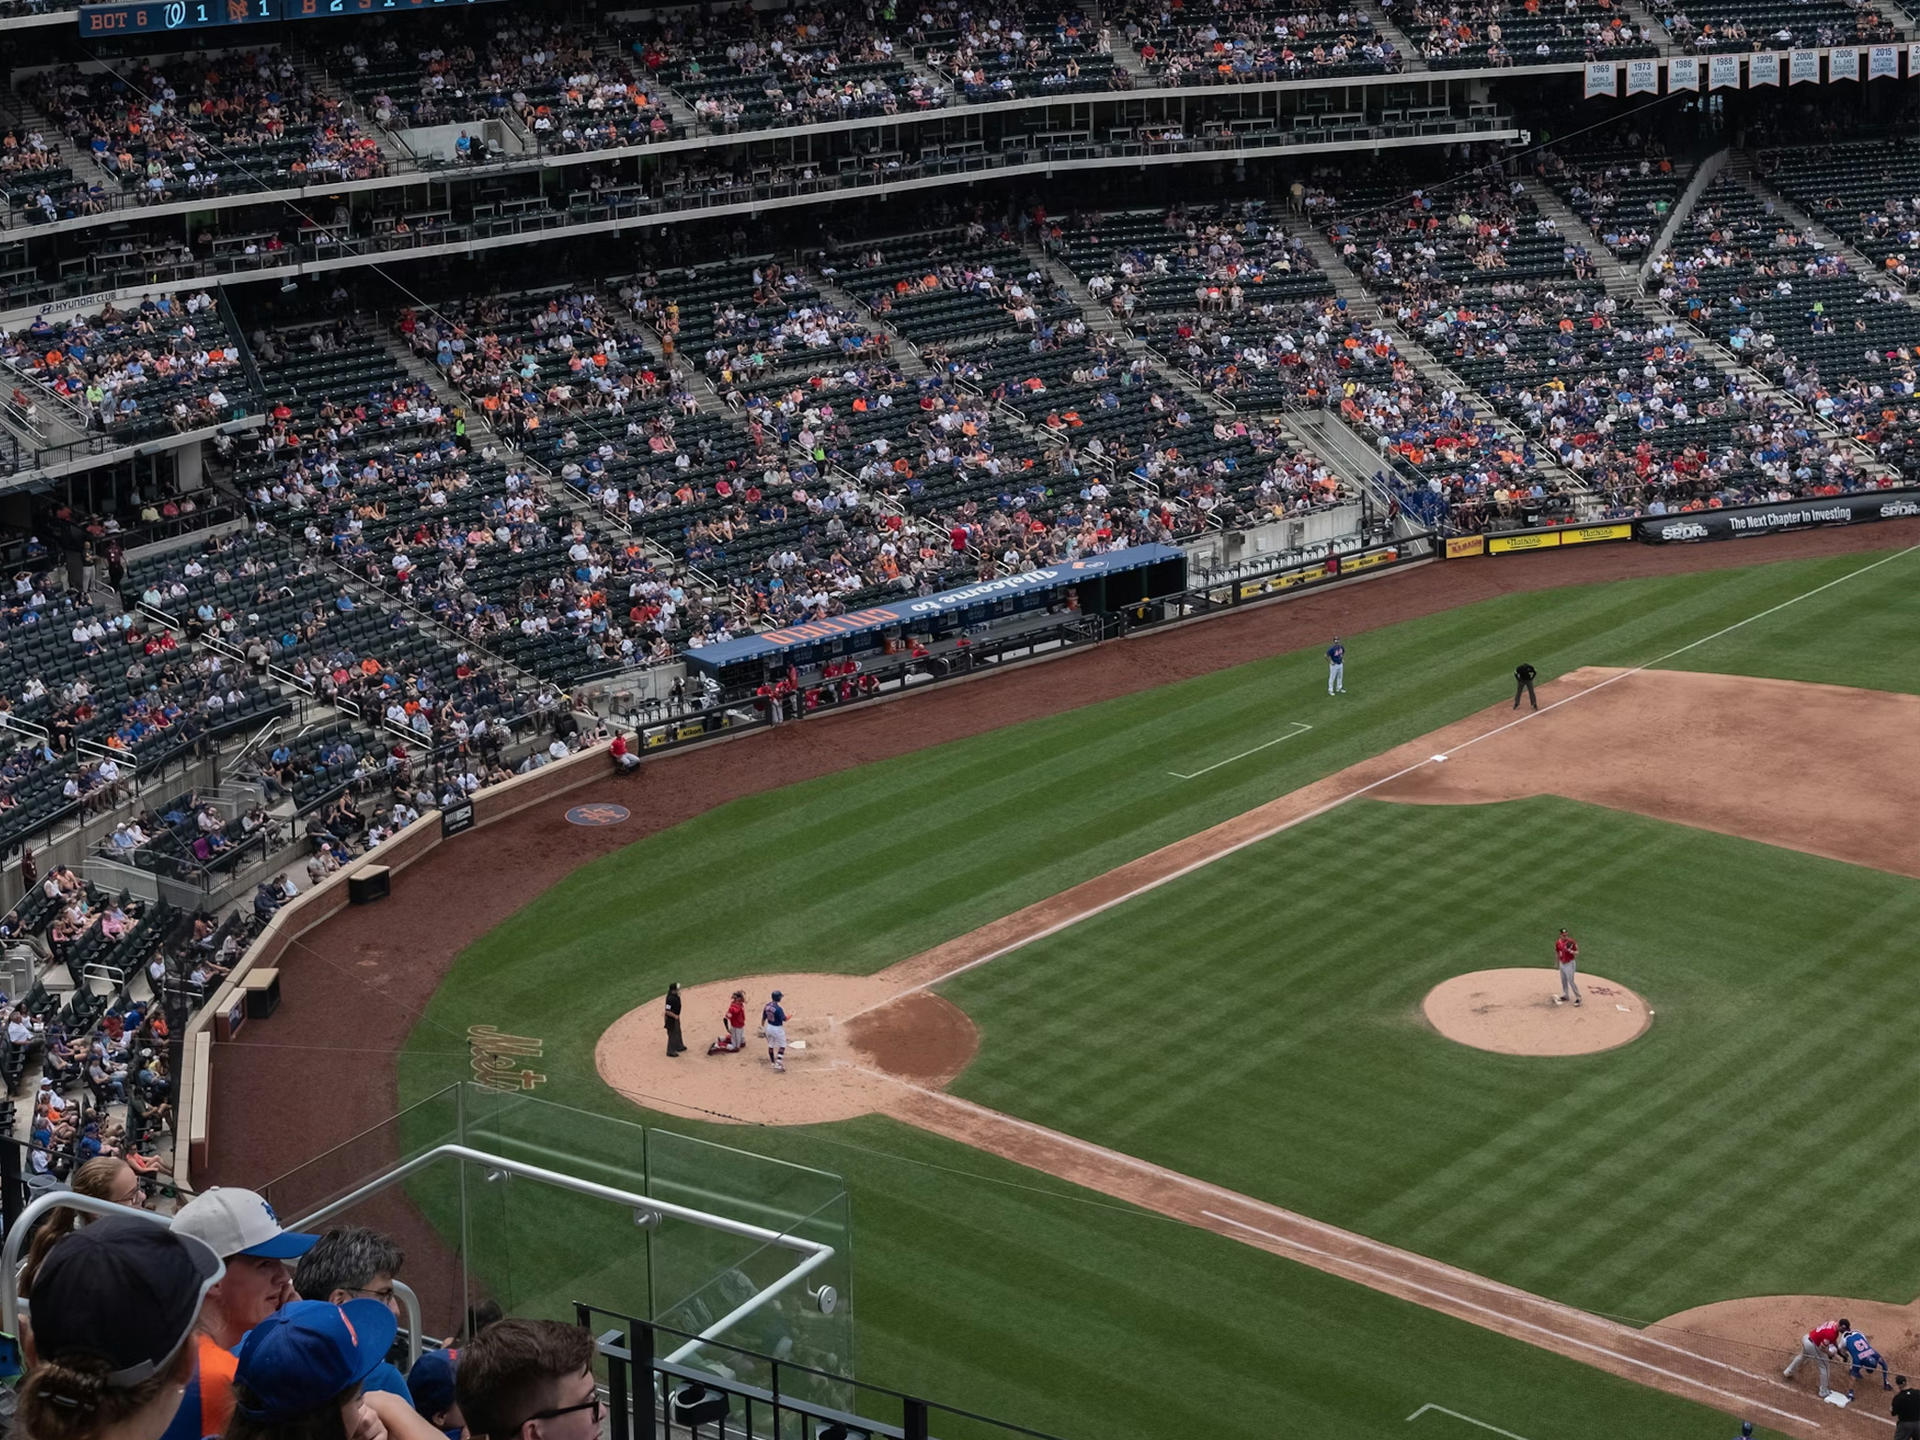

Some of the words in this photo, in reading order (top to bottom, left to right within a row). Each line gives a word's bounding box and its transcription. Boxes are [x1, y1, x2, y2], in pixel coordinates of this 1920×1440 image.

[196, 4, 208, 22] 1
[259, 0, 270, 16] 1
[90, 12, 127, 30] BOT
[136, 11, 147, 26] 6
[1795, 52, 1813, 60] 2000
[1875, 47, 1892, 56] 2015
[1675, 59, 1692, 68] 1986
[1756, 55, 1773, 64] 1999
[1592, 64, 1610, 73] 1969
[1634, 62, 1651, 71] 1973
[55, 296, 95, 311] HYUNDAI
[96, 292, 117, 302] CLUB
[1728, 517, 1746, 530] The
[1747, 515, 1767, 529] Next
[1767, 511, 1801, 526] Chapter
[1801, 510, 1811, 522] In
[1811, 506, 1852, 521] Investing
[939, 570, 1058, 601] Welcome
[911, 601, 942, 611] to
[836, 608, 900, 627] CITI
[761, 621, 847, 645] FIELD
[682, 727, 703, 737] Nikon
